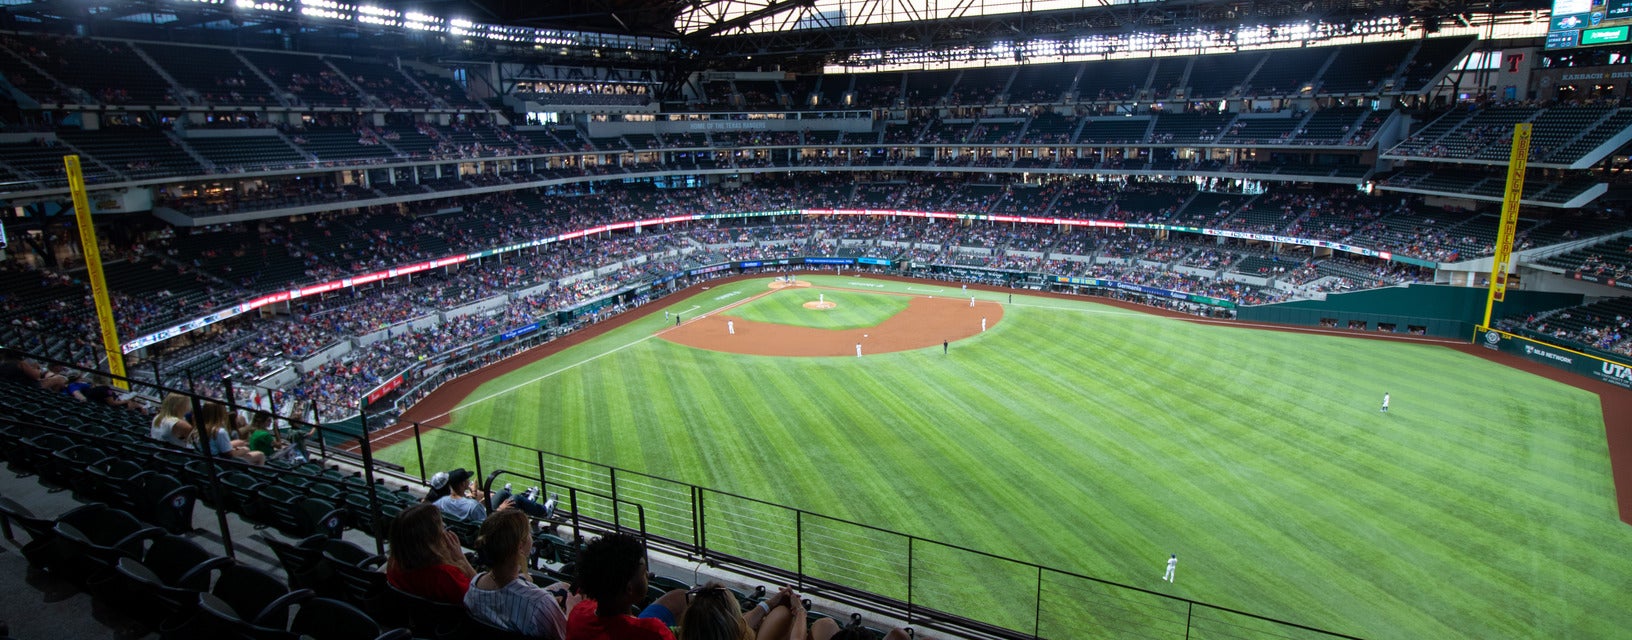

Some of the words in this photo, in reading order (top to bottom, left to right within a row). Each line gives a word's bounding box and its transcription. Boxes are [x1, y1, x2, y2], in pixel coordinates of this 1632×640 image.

[1562, 73, 1603, 81] KARBACH
[1513, 139, 1527, 190] BRING
[1508, 192, 1518, 220] THE
[1502, 224, 1513, 262] HEAT
[1117, 283, 1142, 291] Germania
[1545, 351, 1573, 364] NETWORK
[1602, 361, 1632, 380] UTA
